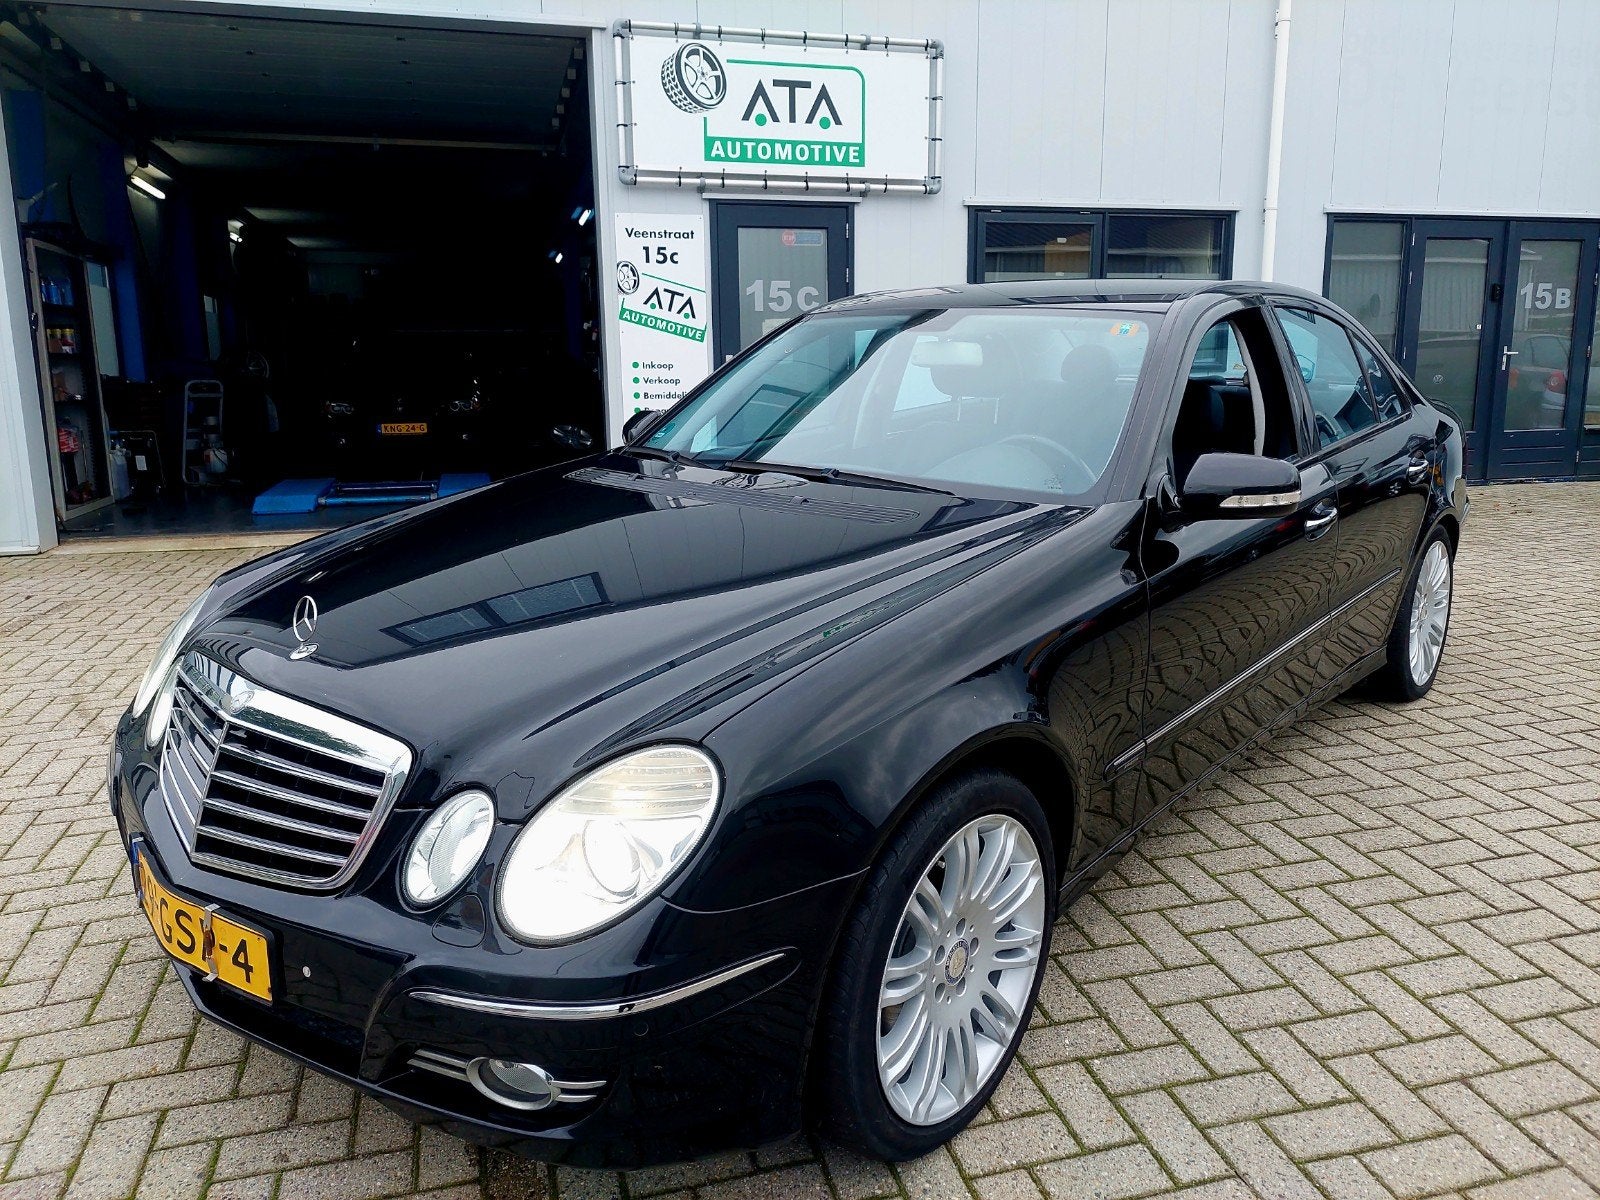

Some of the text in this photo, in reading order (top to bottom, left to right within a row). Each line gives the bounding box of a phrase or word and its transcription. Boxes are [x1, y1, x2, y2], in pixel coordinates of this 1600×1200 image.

[741, 79, 843, 130] ATA
[711, 140, 860, 163] AUTOMOTIVE
[625, 227, 695, 240] Veenstraat
[643, 286, 696, 319] ATA
[1520, 283, 1571, 310] 15B
[622, 312, 702, 340] AUTOMOTIVE
[642, 361, 674, 371] Inkoop
[643, 377, 681, 386] Verkoop
[383, 424, 425, 433] KNG-24-G
